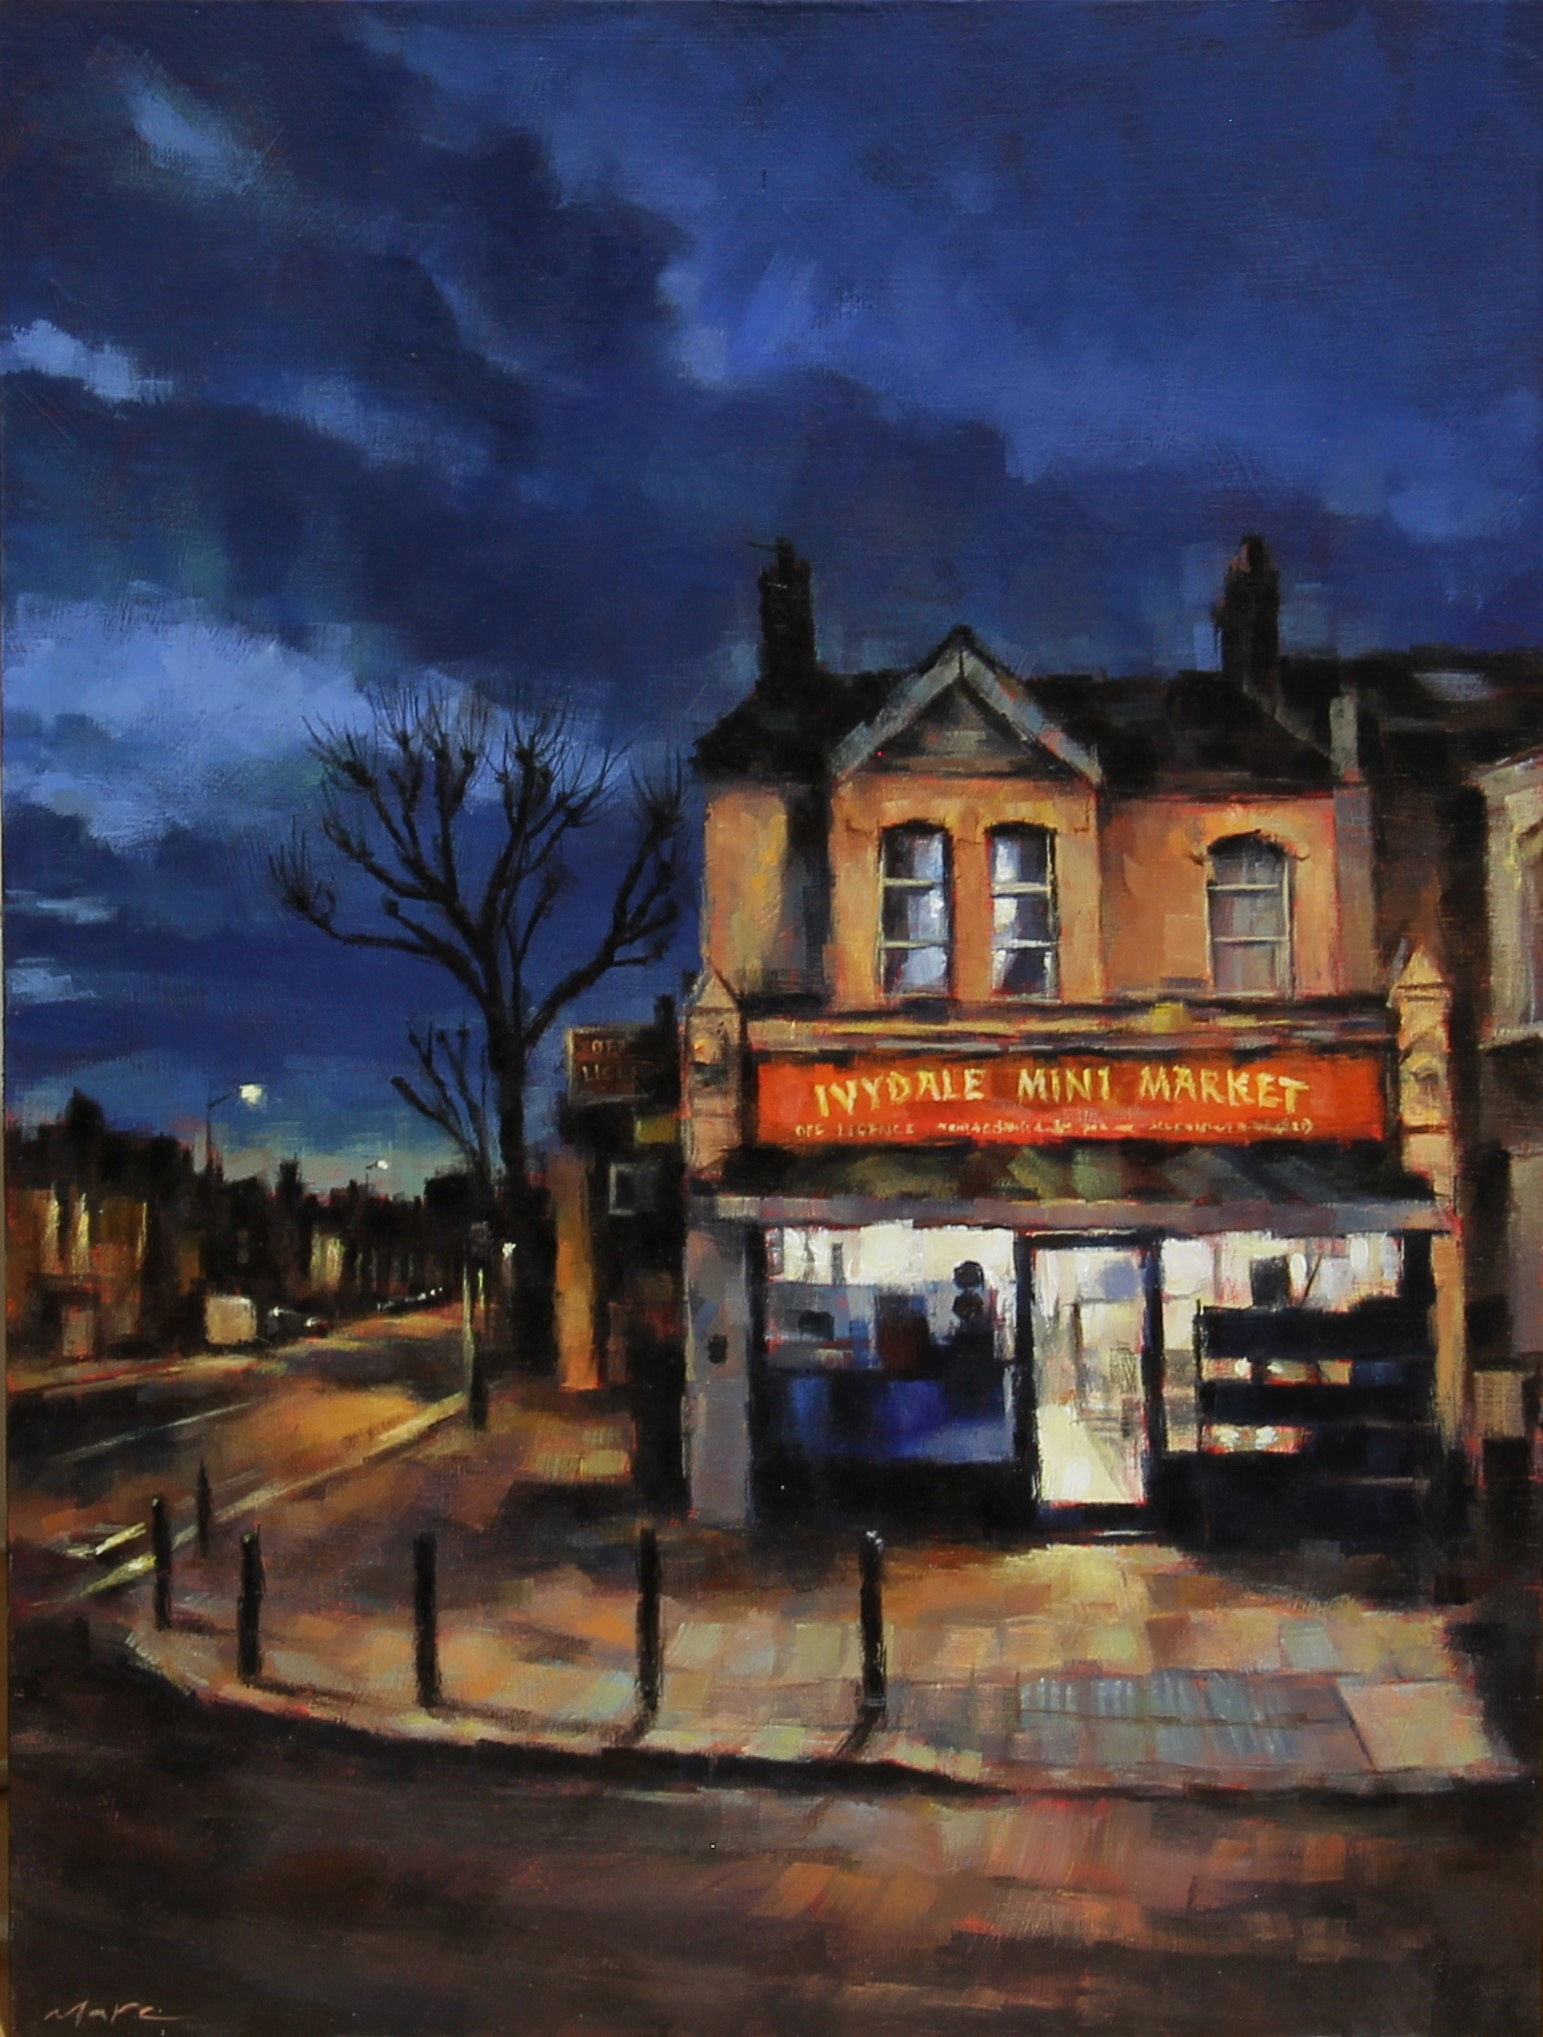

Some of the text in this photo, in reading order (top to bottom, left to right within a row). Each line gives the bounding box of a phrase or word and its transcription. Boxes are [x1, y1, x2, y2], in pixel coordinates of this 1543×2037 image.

[814, 1066, 1309, 1117] IVYDALE MINI MARKET
